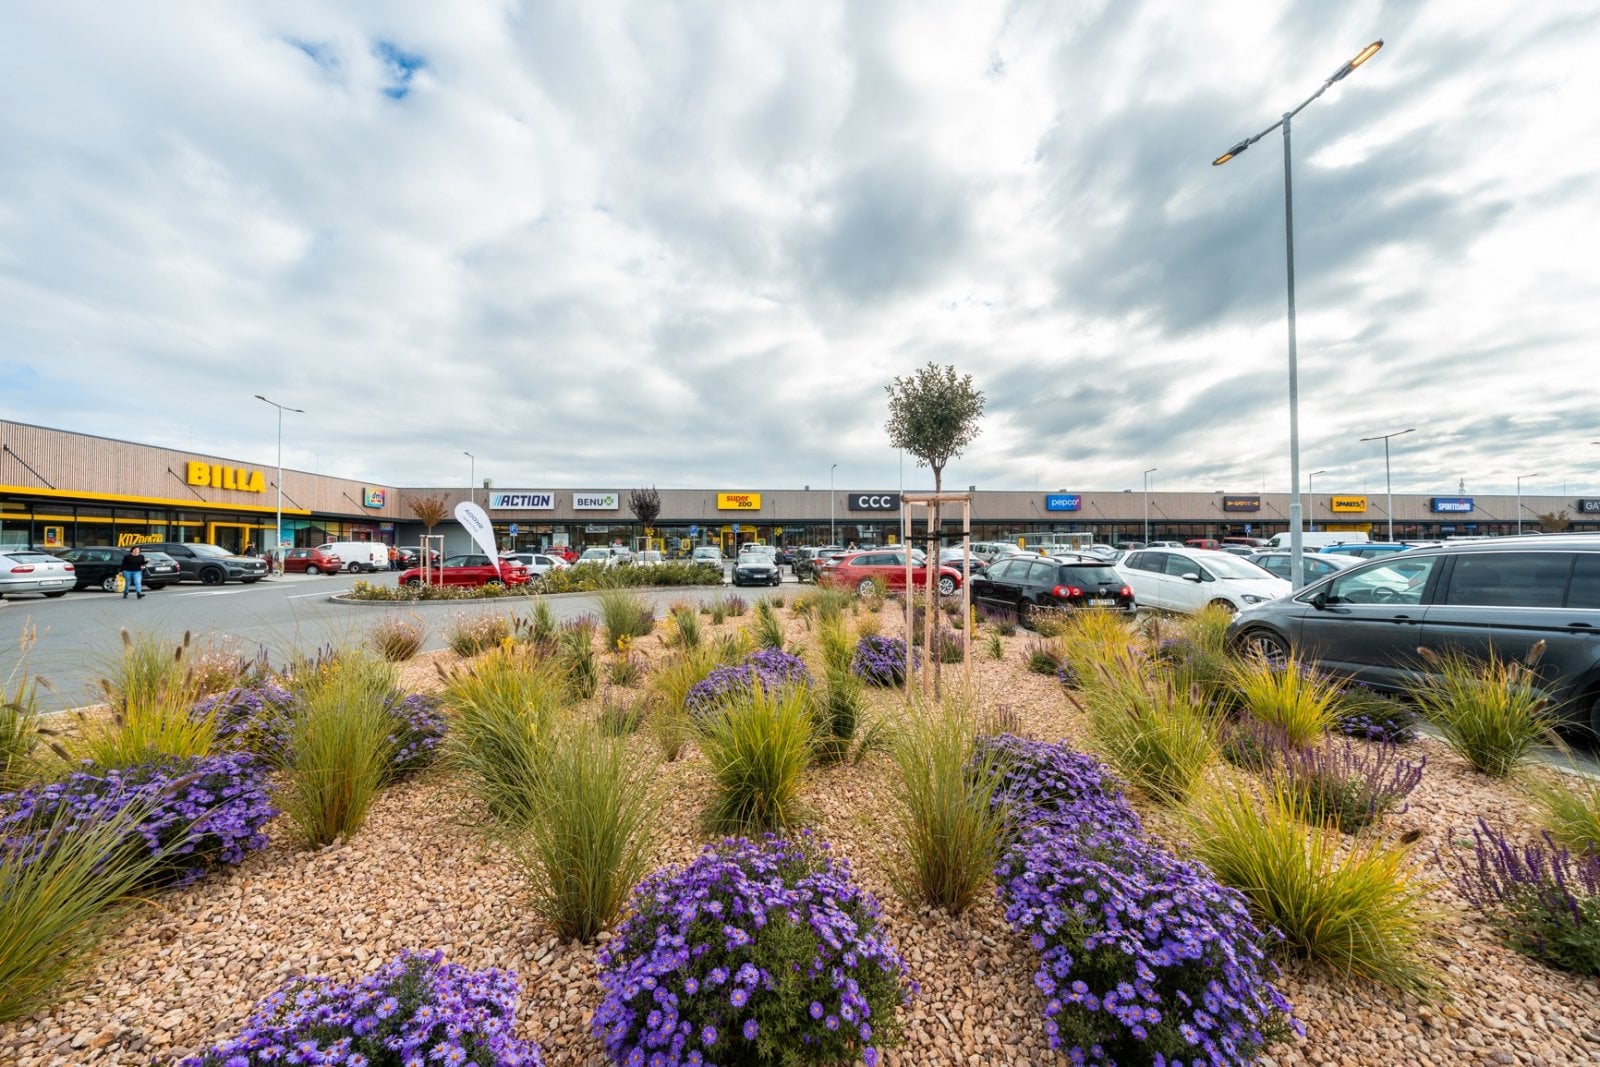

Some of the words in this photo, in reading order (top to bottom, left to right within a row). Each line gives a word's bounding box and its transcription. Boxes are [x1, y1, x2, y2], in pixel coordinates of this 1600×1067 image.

[188, 461, 266, 493] BILLA
[500, 495, 550, 506] ACTION
[577, 498, 603, 506] BENU
[859, 496, 891, 507] CCC
[1051, 499, 1077, 507] pepco
[1585, 501, 1600, 510] GA
